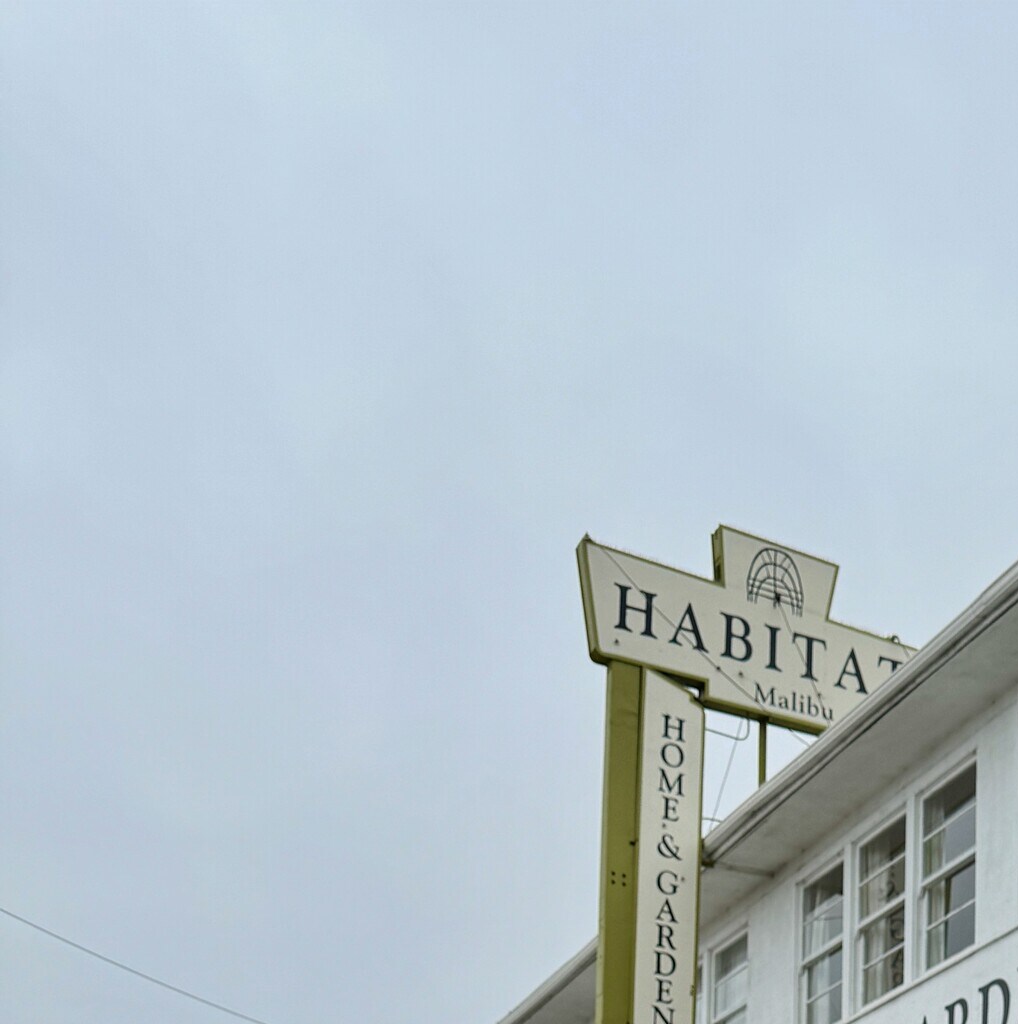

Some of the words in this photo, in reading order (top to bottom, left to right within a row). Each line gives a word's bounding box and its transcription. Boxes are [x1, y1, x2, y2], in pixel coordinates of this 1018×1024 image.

[754, 682, 834, 721] Malibu
[658, 714, 686, 822] HOME
[657, 834, 683, 862] &
